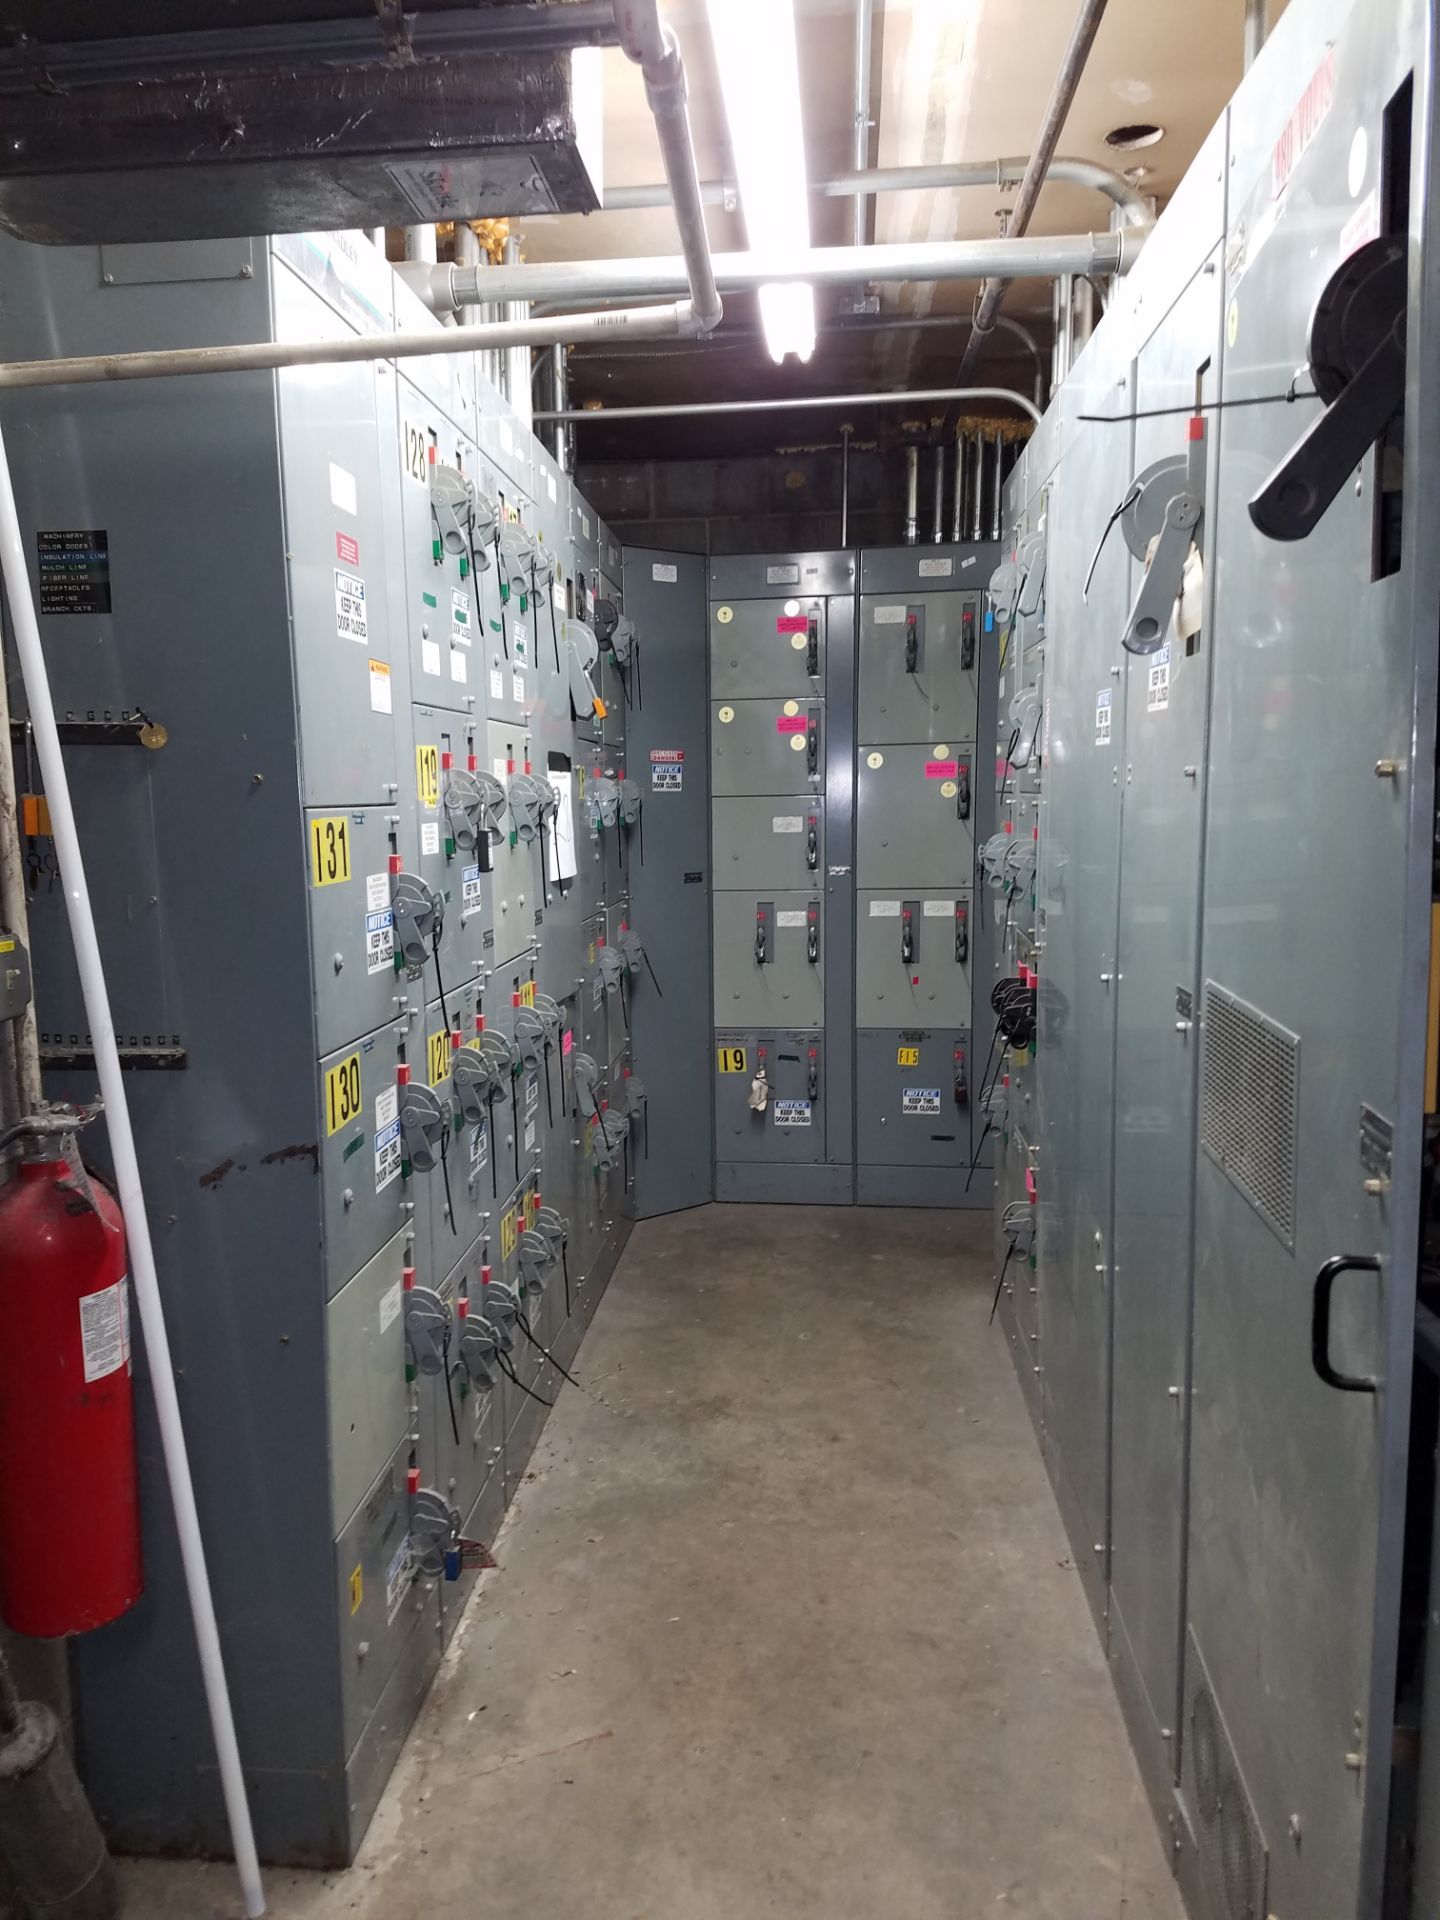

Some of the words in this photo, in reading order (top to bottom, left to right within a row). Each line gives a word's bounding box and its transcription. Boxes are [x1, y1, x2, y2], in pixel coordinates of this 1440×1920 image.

[405, 420, 426, 483] 128
[41, 552, 85, 560] INSULATION
[89, 552, 107, 560] LINE
[337, 572, 364, 599] NOTICE
[420, 748, 437, 796] 119
[316, 822, 348, 882] 131
[368, 911, 392, 931] NOTICE
[371, 932, 381, 949] KEEP
[381, 930, 391, 946] THIS
[723, 1049, 744, 1072] 19
[899, 1050, 918, 1064] F15
[330, 1057, 360, 1130] 130
[906, 1089, 938, 1097] NOTICE
